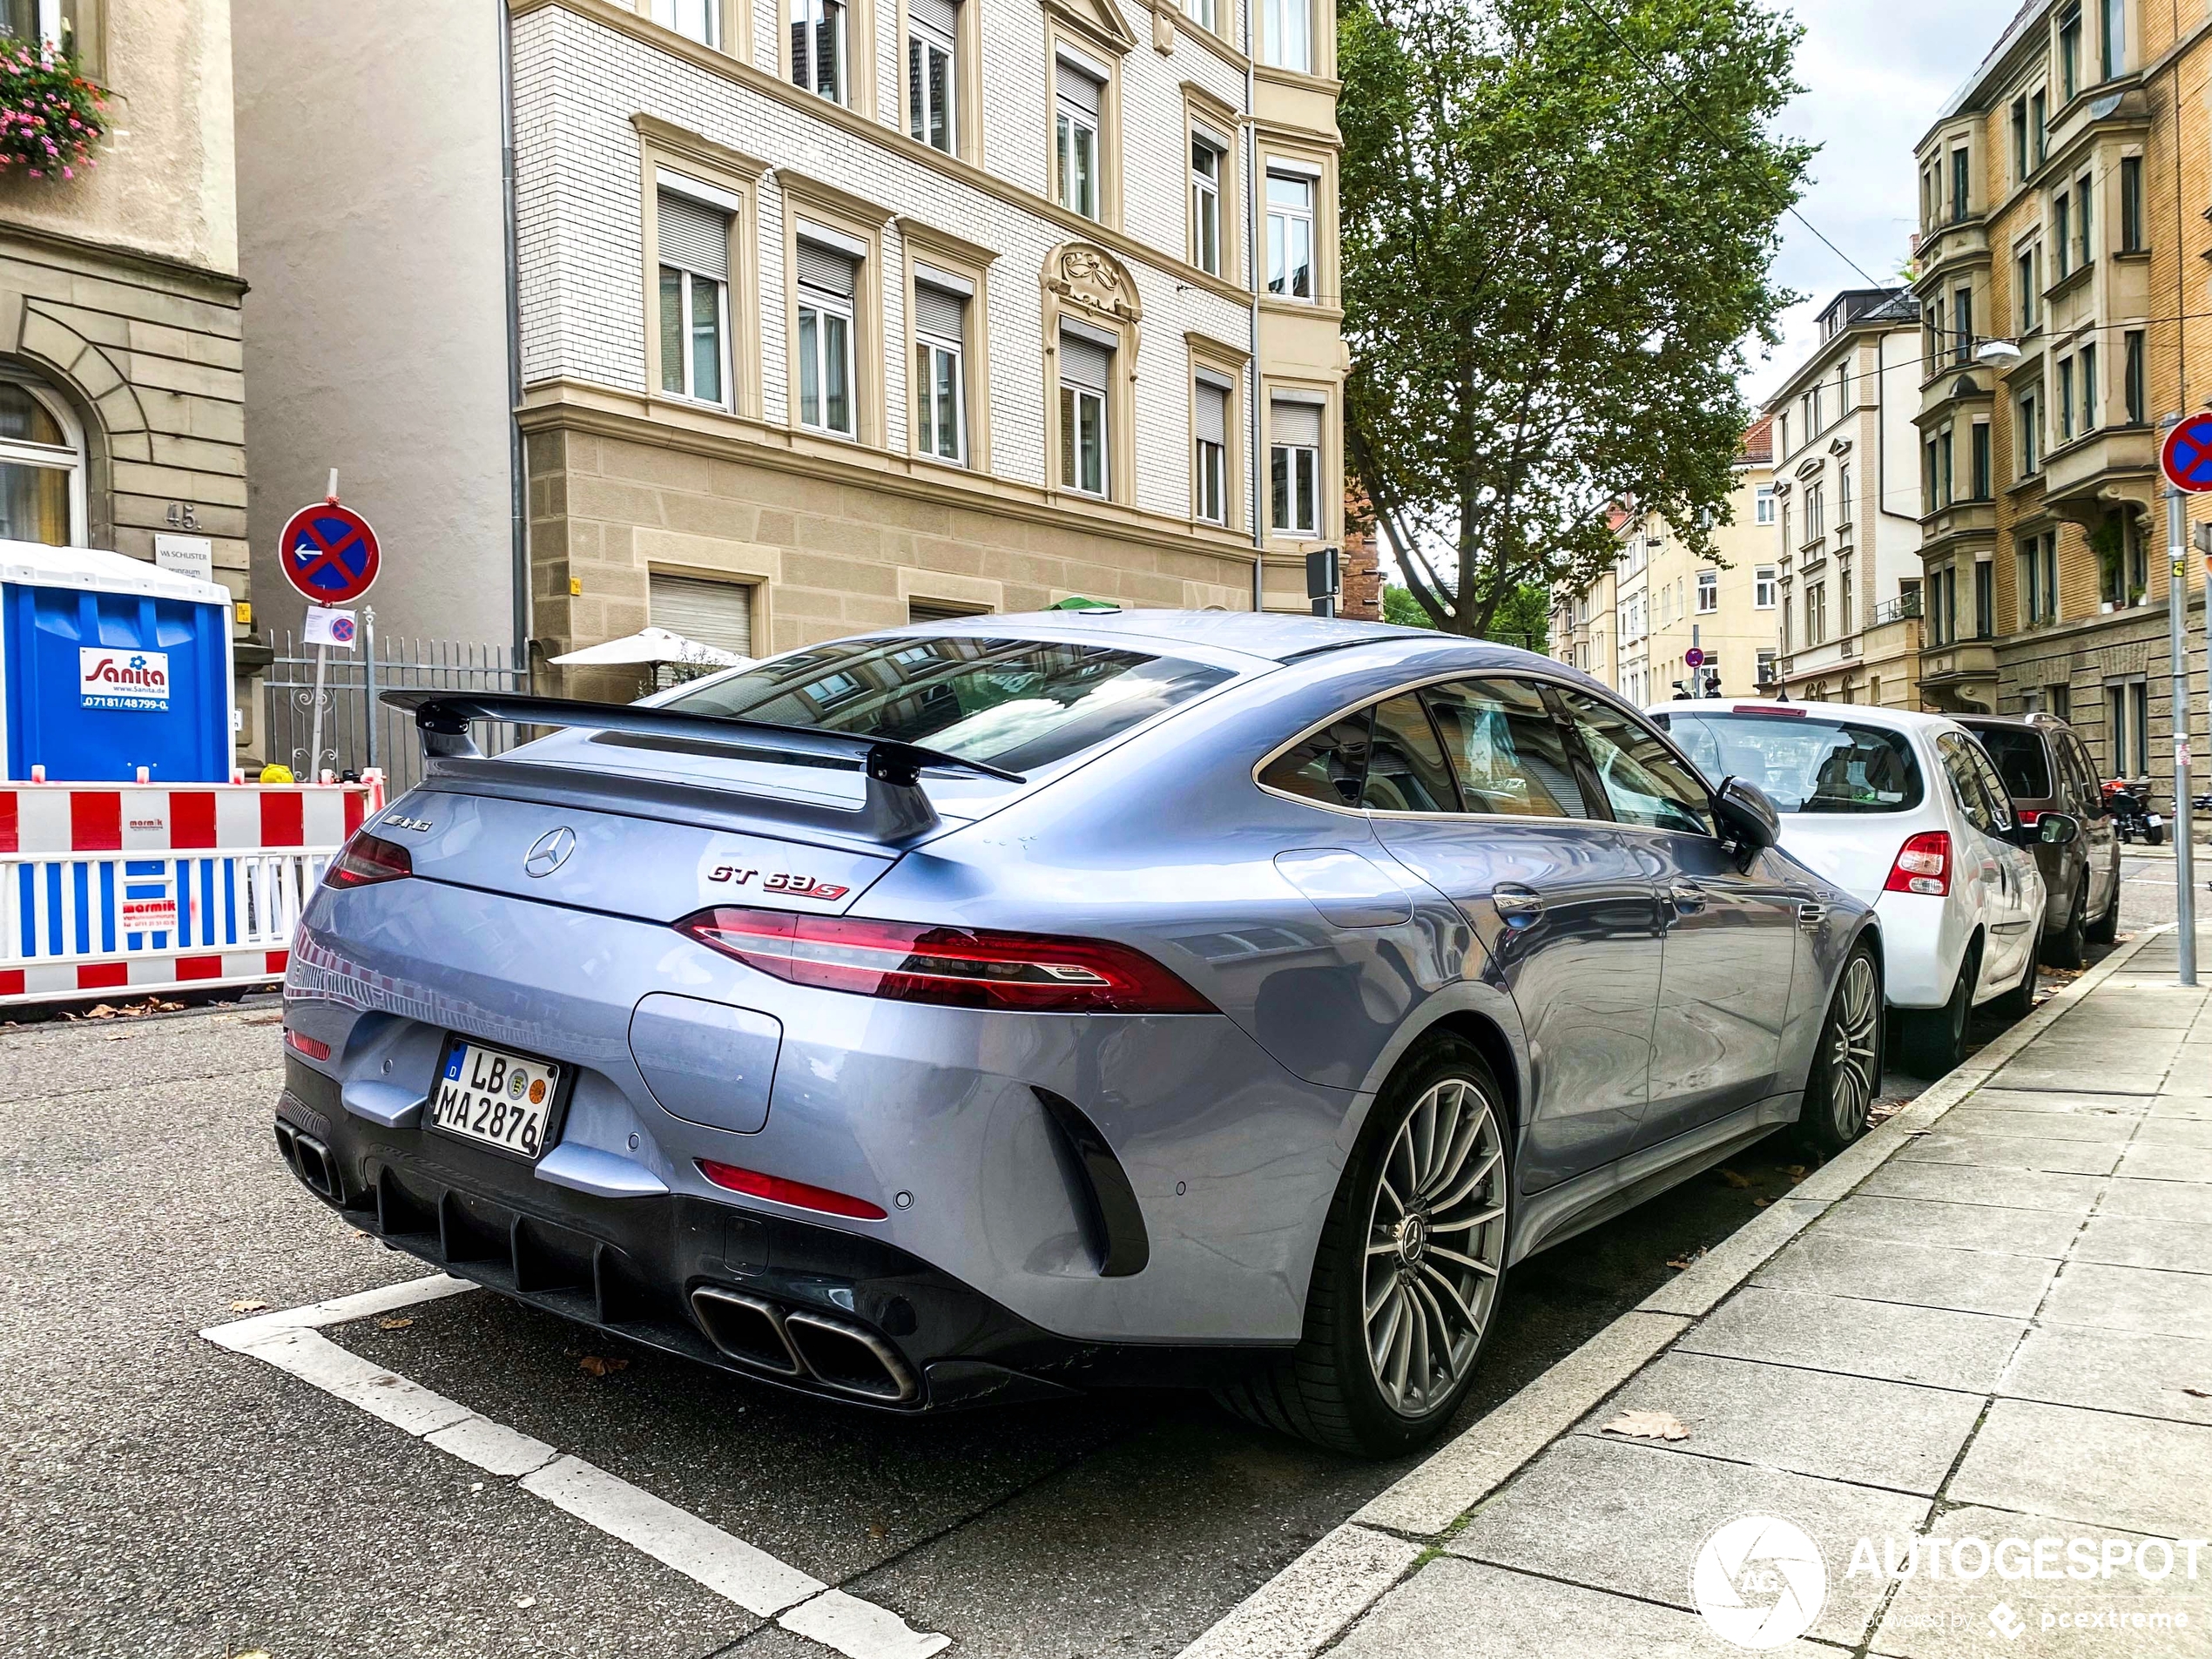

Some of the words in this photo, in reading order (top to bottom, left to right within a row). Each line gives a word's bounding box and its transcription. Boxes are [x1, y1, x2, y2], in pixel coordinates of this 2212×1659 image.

[172, 551, 207, 561] SCHUSTER
[85, 659, 165, 687] Sanita
[85, 697, 165, 710] 07181/48799-0
[708, 864, 759, 885] GT
[123, 900, 176, 914] marmik
[449, 1066, 457, 1077] D
[471, 1053, 507, 1094] LB
[435, 1085, 471, 1129] MA
[472, 1097, 538, 1149] 2876
